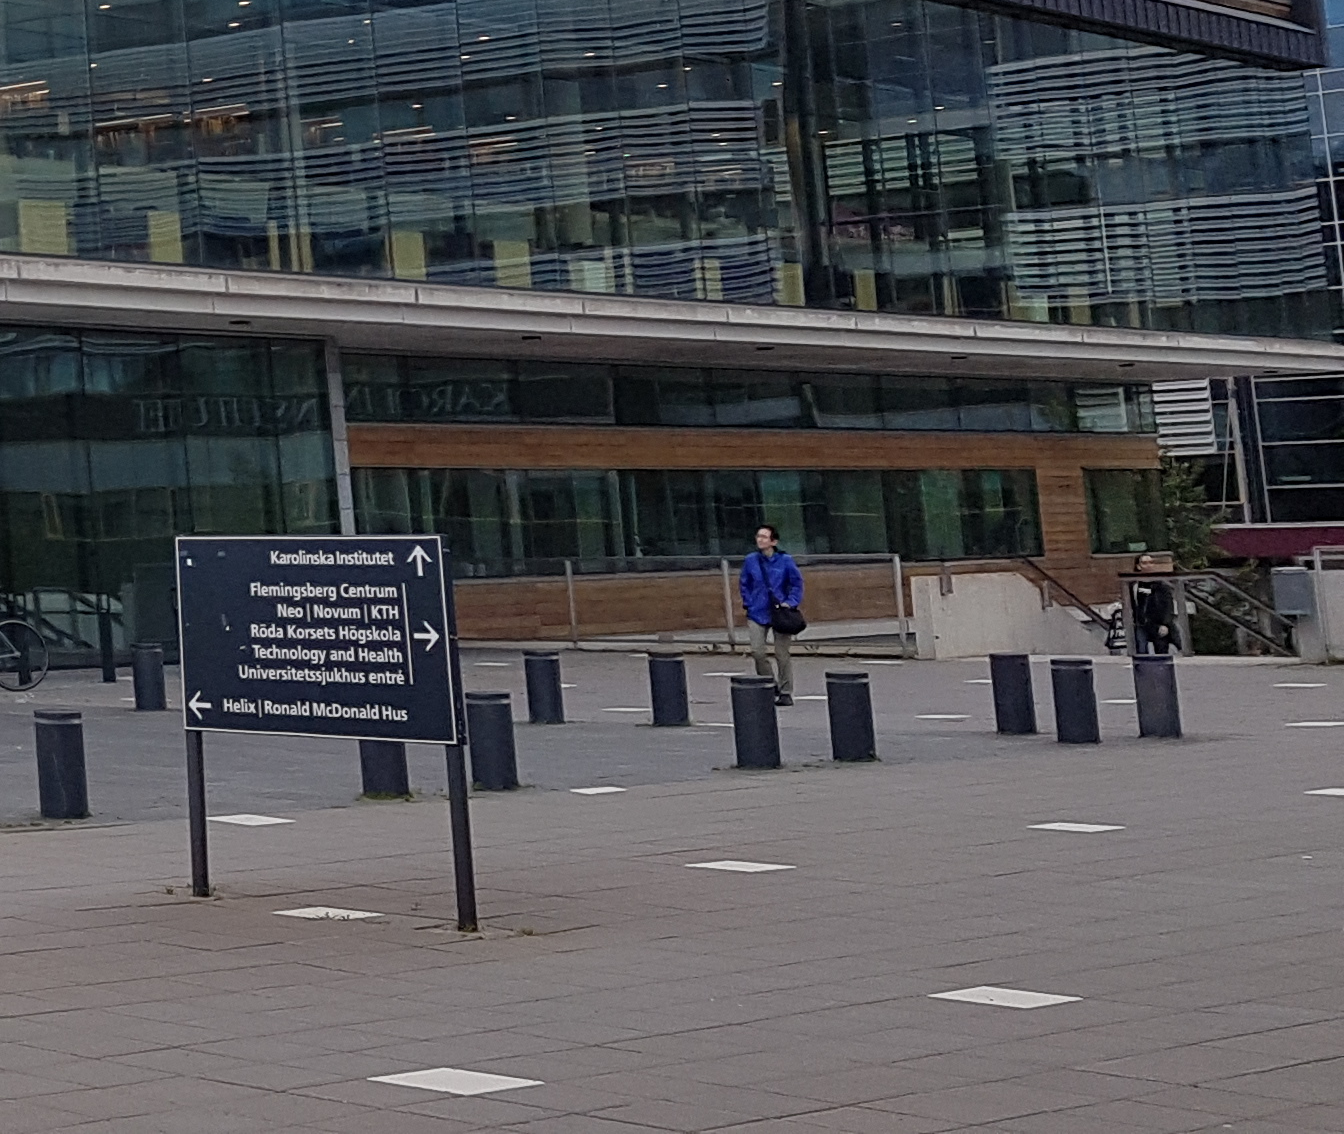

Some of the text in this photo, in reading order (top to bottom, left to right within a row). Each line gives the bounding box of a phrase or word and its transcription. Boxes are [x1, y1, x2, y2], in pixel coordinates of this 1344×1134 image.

[270, 550, 395, 566] Karolinska Institutet
[250, 582, 398, 601] Flemingsberg Centrum
[277, 604, 399, 619] Neo Novum KTH
[250, 624, 402, 645] Röda Korsets Högskola
[251, 644, 403, 664] Technology and Health
[238, 665, 405, 686] Universitetssjukhus entré
[223, 698, 408, 721] Helix Ronald McDonald Hus
